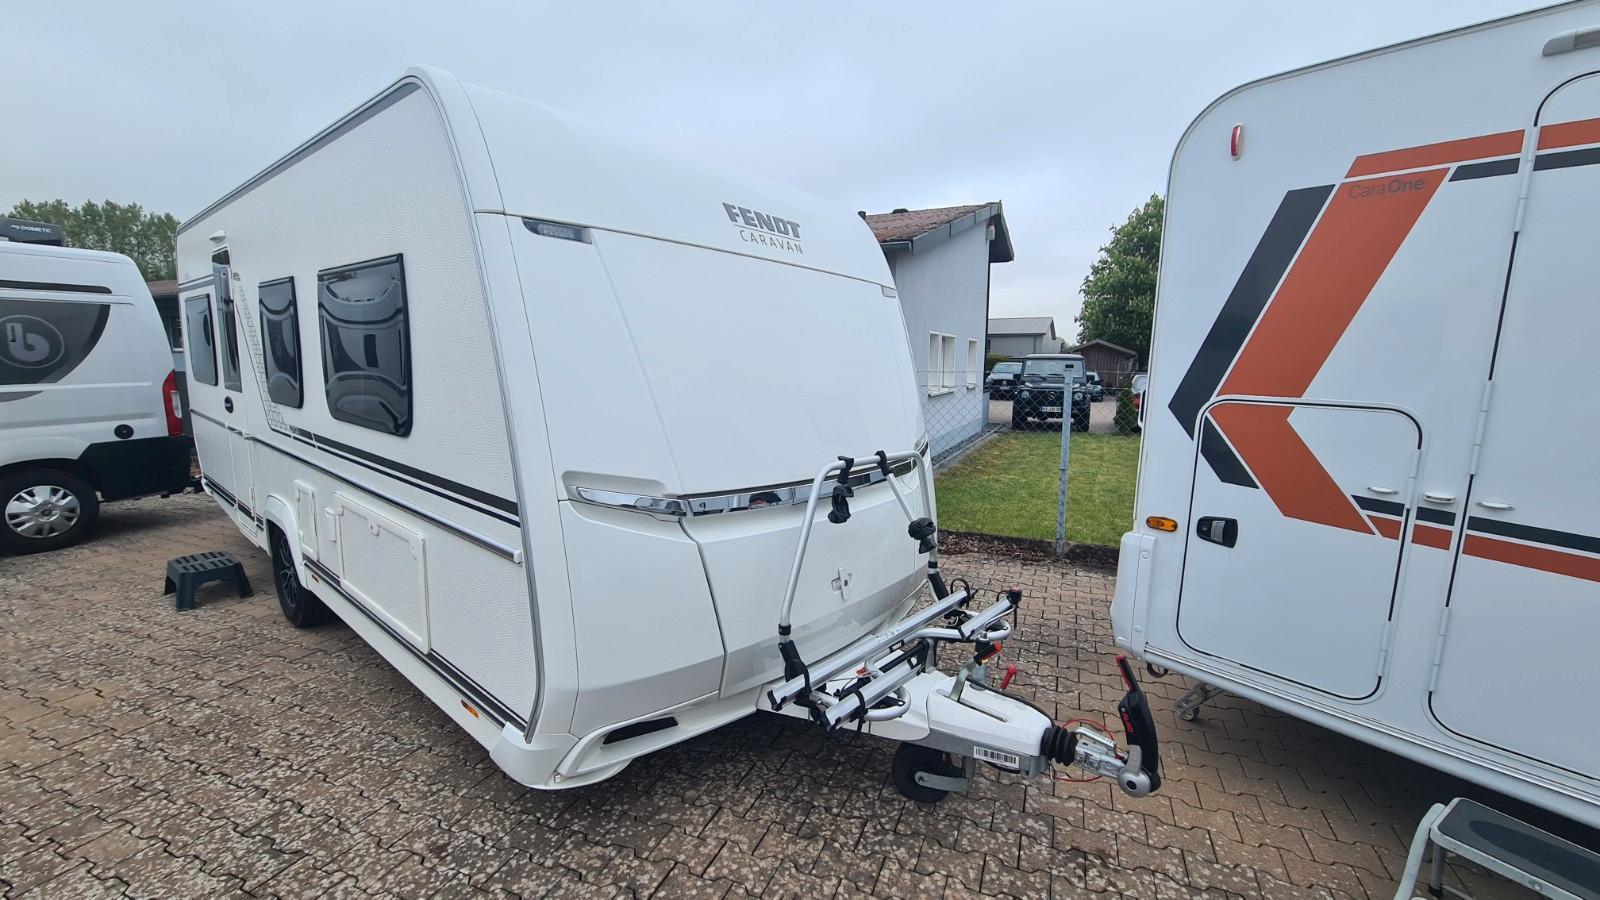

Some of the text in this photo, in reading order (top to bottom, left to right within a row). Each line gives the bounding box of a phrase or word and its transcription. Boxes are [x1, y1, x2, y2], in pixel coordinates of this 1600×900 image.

[1348, 178, 1425, 199] CaraOne
[722, 202, 801, 239] FENDT
[739, 229, 803, 254] CARAVAN
